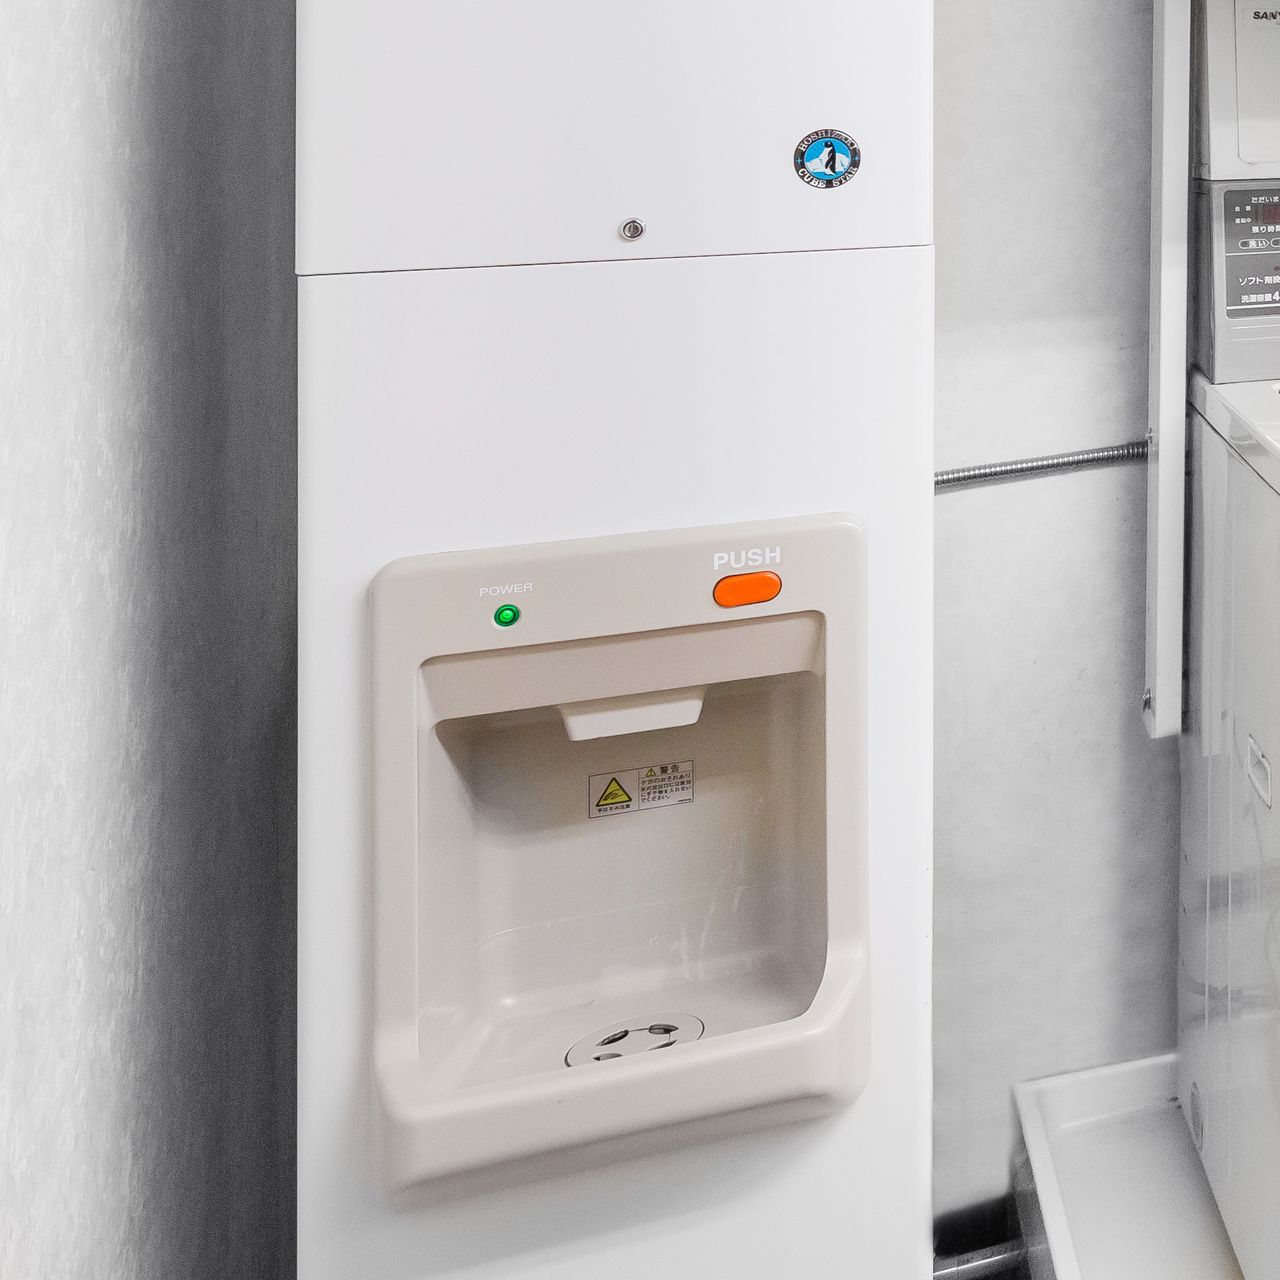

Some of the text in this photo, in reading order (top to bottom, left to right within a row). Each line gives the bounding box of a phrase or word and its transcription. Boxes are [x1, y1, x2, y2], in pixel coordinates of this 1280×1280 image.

[798, 167, 858, 188] CUBE STAR
[713, 546, 782, 570] PUSH
[479, 582, 533, 597] POWER
